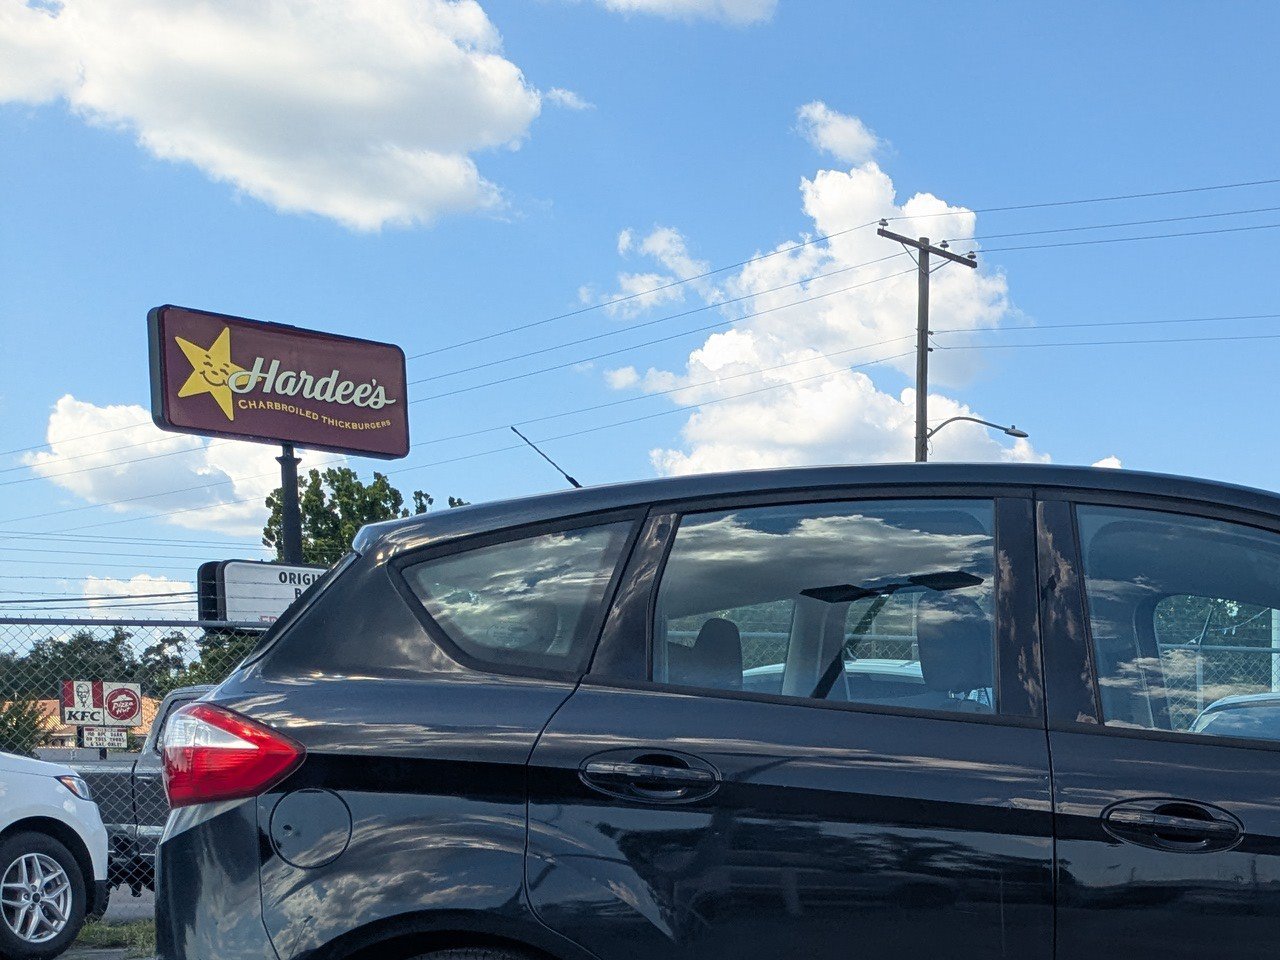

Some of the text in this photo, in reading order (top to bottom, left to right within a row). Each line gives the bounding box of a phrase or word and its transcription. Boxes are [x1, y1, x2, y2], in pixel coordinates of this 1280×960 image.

[227, 357, 396, 410] Hardee's
[238, 399, 391, 431] CHARBROILED THICKBURGERS
[67, 711, 101, 722] KFC
